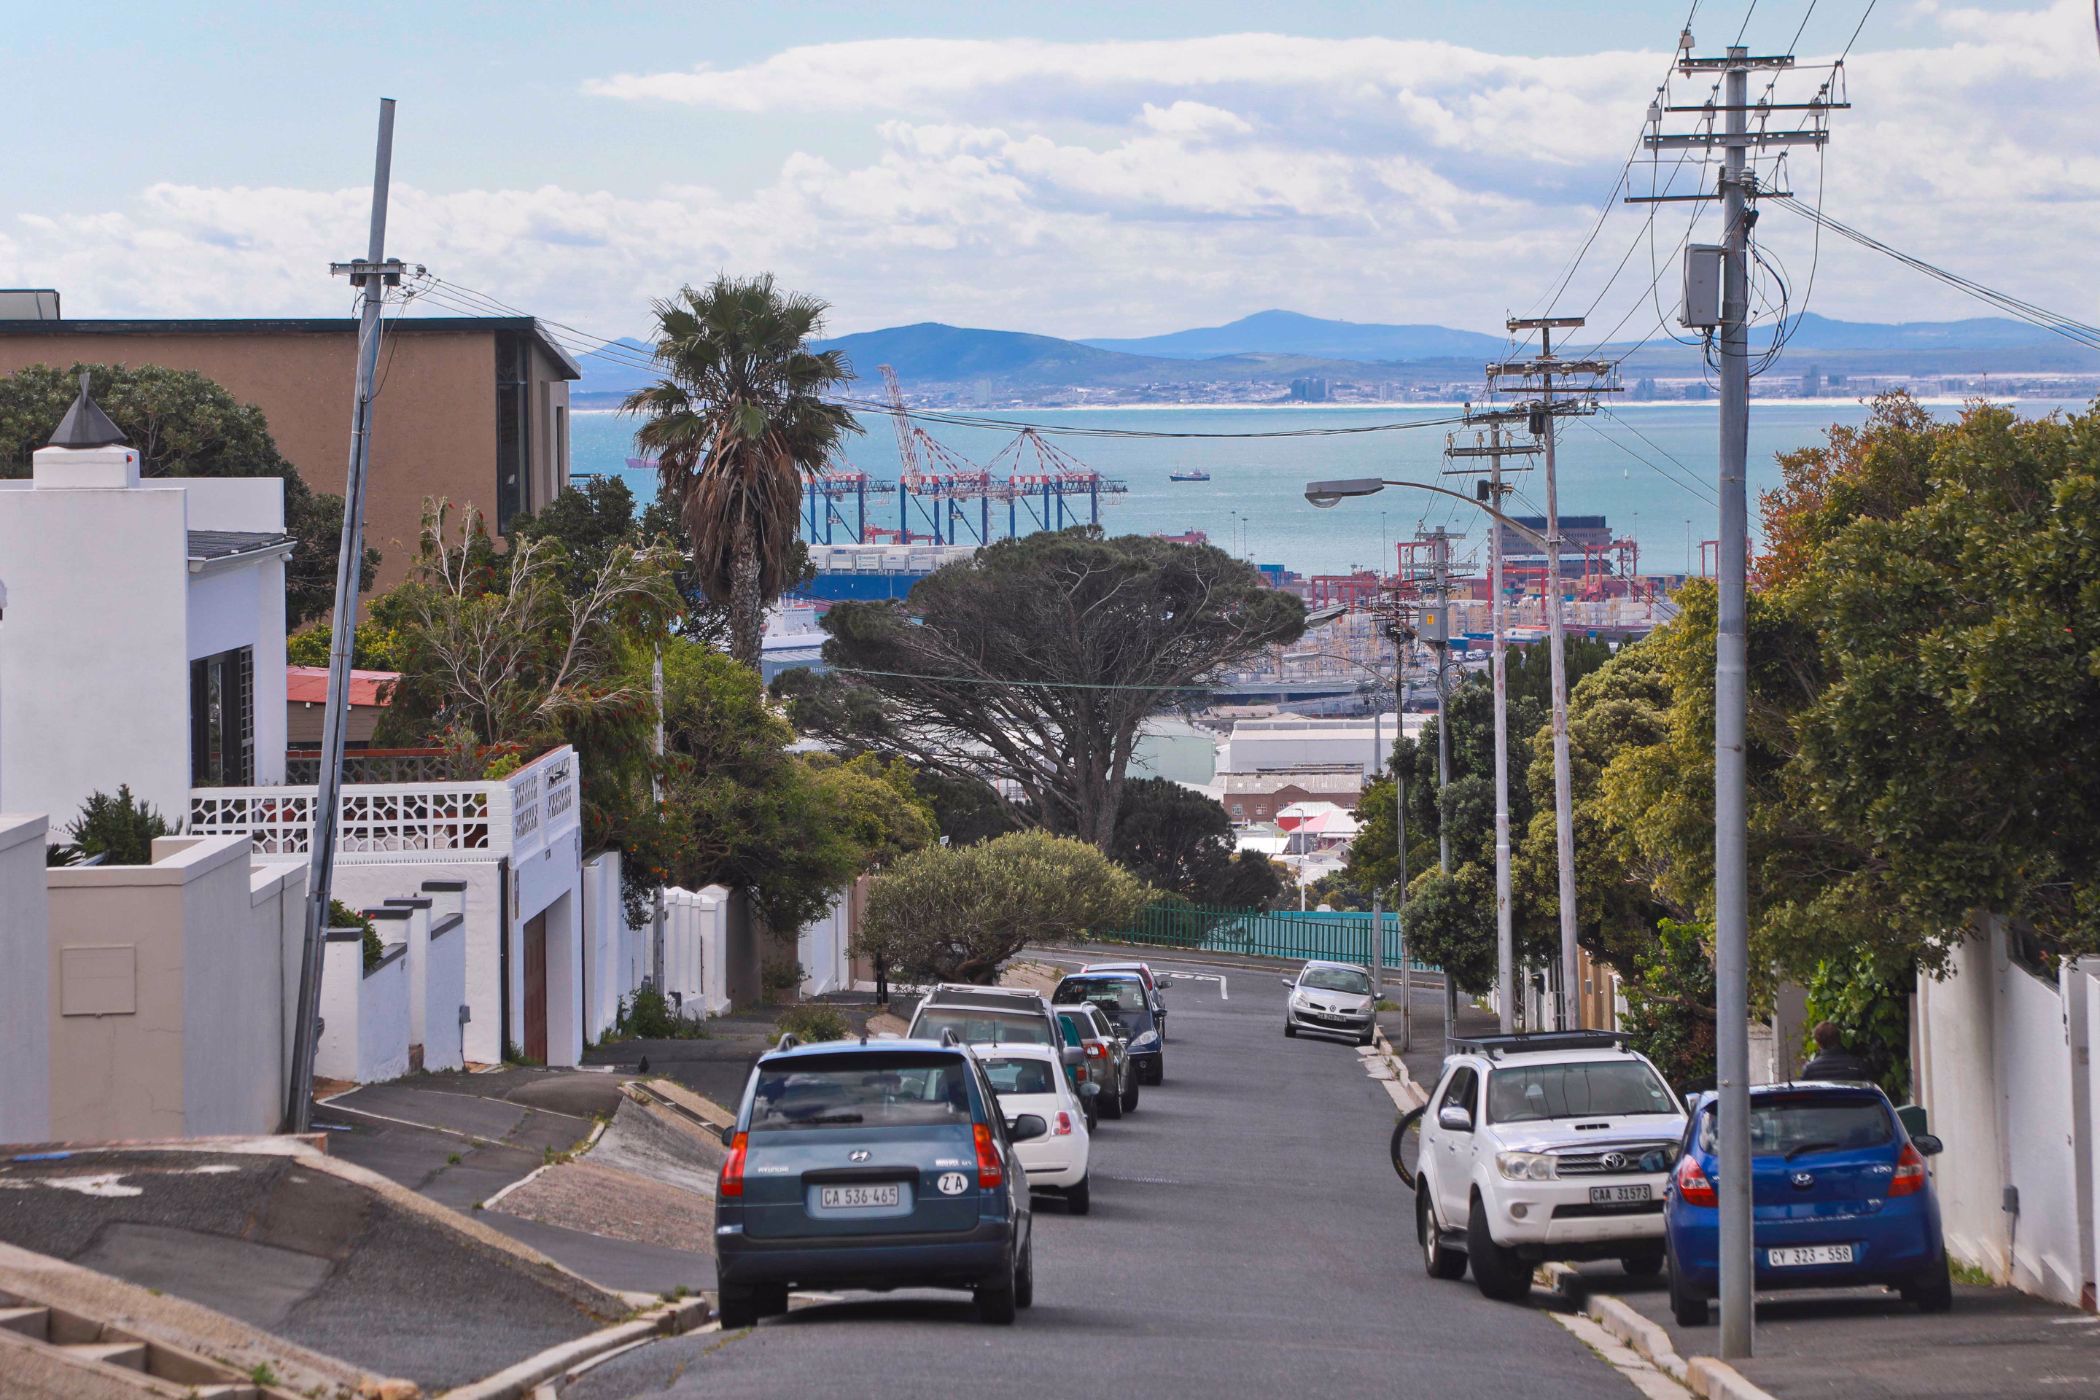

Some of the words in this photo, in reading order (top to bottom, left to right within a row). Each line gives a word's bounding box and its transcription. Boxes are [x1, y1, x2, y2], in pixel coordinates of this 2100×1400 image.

[824, 1190, 840, 1206] CA
[1592, 1189, 1612, 1202] CAA
[1617, 1187, 1649, 1201] 31573
[1771, 1250, 1786, 1265] CY
